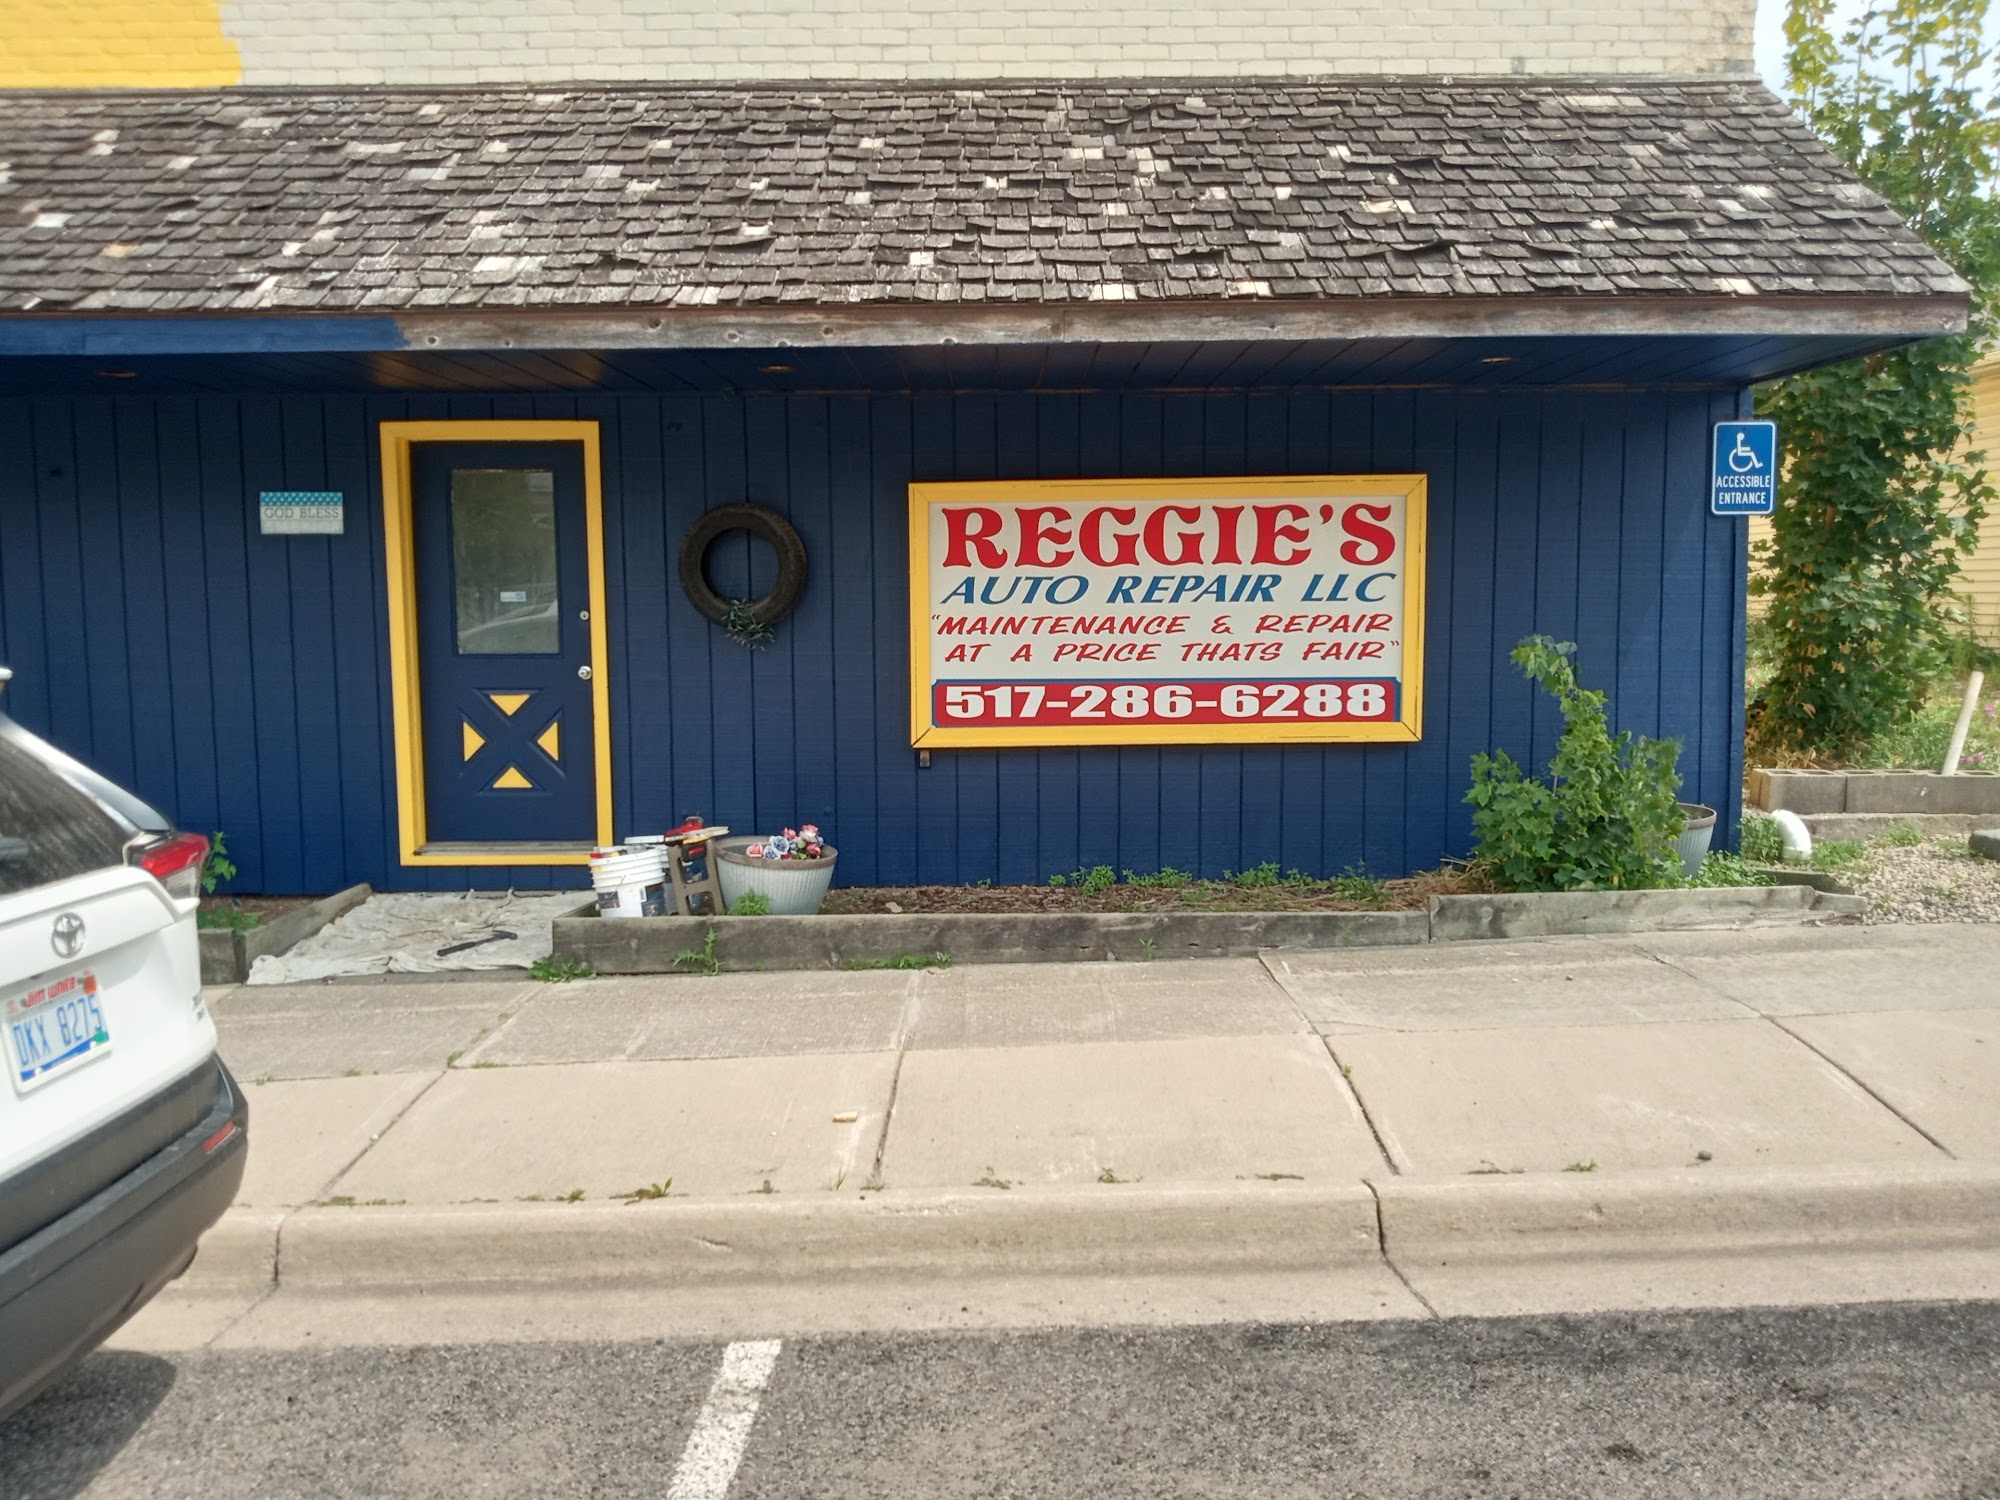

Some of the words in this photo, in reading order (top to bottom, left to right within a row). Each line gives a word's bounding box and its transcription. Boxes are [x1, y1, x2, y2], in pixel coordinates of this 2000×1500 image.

[1716, 475, 1770, 488] ACCESSIBLE
[1719, 491, 1766, 504] ENTRANCE
[264, 507, 294, 519] GOD
[299, 507, 339, 519] BLESS
[941, 503, 1396, 569] REGGIE'S
[940, 575, 1090, 605] AUTO
[1105, 573, 1282, 604] REPAIR
[1300, 572, 1397, 603] LLC
[1211, 615, 1234, 634] &
[1255, 613, 1393, 634] REPAIR
[944, 643, 992, 662] AT
[1009, 643, 1033, 662] A
[1052, 643, 1162, 662] PRICE
[1180, 641, 1283, 662] THATS
[945, 683, 1386, 719] 517-286-6288
